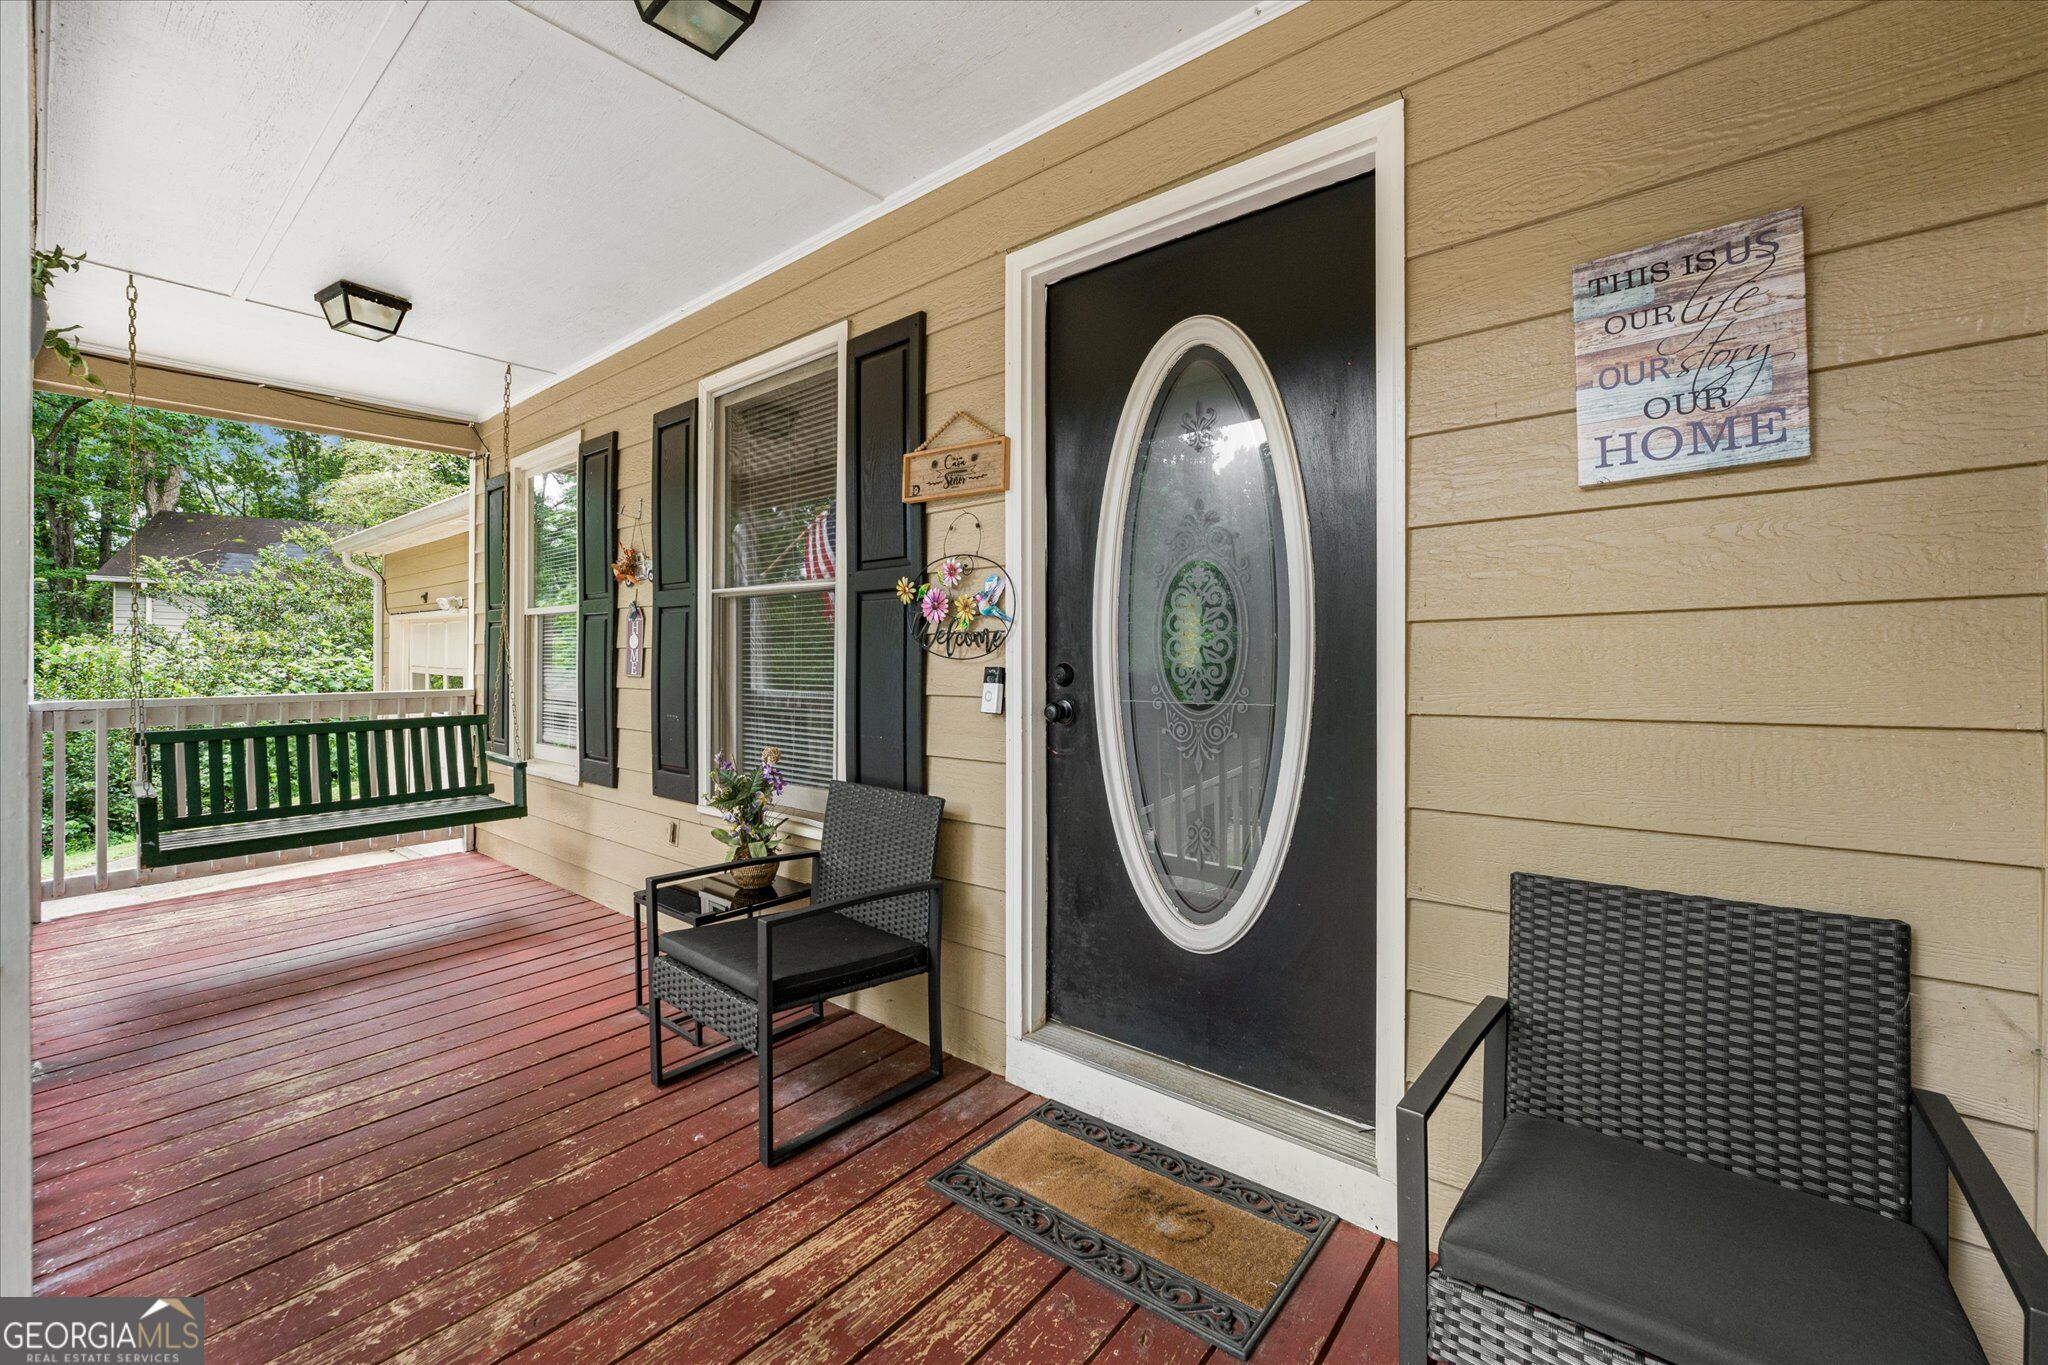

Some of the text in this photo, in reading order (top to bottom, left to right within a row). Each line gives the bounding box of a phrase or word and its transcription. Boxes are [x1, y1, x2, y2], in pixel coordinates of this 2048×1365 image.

[1588, 229, 1780, 298] THIS IS US
[1604, 248, 1776, 357] OUR life
[1599, 318, 1797, 413] OUR story
[1643, 386, 1731, 420] OUR
[1593, 407, 1788, 469] HOME
[911, 611, 1004, 658] Welcome
